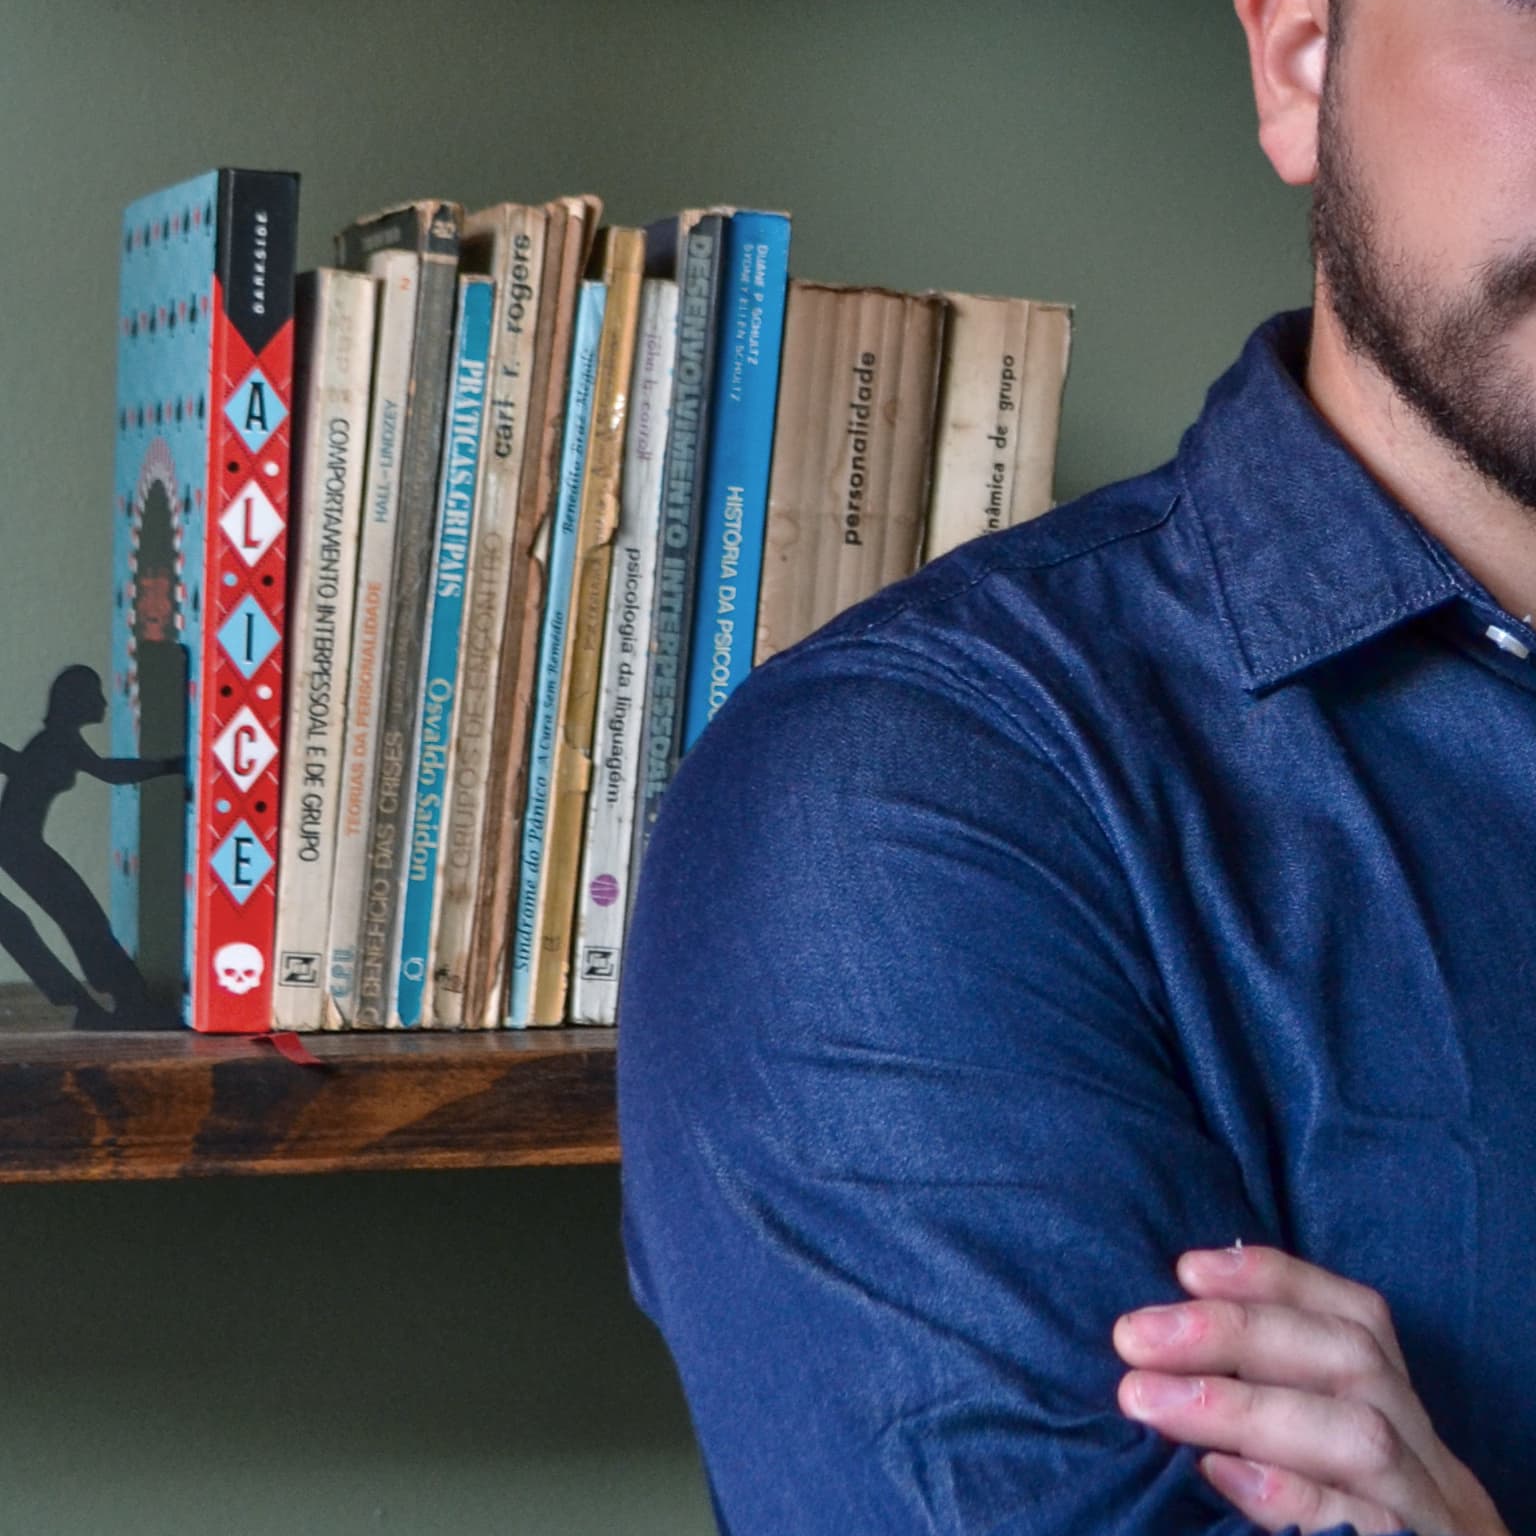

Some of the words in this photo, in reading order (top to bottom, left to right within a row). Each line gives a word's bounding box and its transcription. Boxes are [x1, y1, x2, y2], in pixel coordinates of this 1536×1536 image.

[251, 210, 270, 315] DARKSIDE
[506, 233, 533, 333] rogers
[504, 359, 522, 379] r.
[748, 306, 767, 366] SCHULTZ
[494, 399, 516, 458] carl
[665, 234, 713, 549] DESENVOLVIMENTO
[986, 424, 1008, 449] de
[999, 354, 1016, 412] grupo
[845, 351, 876, 546] personalidade
[318, 417, 351, 599] COMPORTAMENTO
[438, 490, 472, 597] GRUPAIS
[232, 381, 270, 887] ALICE
[468, 531, 503, 687] ENCONTRO
[547, 610, 565, 673] Remédio
[617, 547, 641, 654] psicologia
[716, 585, 737, 615] DA
[305, 604, 335, 740] INTERPESSOAL
[356, 579, 382, 728] PERSONALIDADE
[543, 679, 558, 708] Sem
[617, 662, 634, 688] da
[647, 557, 686, 798] INTERPESSOAL
[306, 745, 327, 757] E
[353, 732, 369, 756] DA
[418, 676, 453, 787] Osvaldo
[463, 702, 487, 738] DE
[539, 714, 554, 750] Cura
[605, 698, 632, 803] linguagem
[304, 763, 326, 787] DE
[344, 761, 366, 838] TEORIAS
[380, 730, 404, 814] CRISES
[451, 747, 484, 870] GRUPOS
[526, 775, 548, 842] Pânico
[299, 792, 322, 862] GRUPO
[373, 823, 395, 869] DAS
[409, 791, 442, 882] Saidon
[522, 847, 543, 873] do
